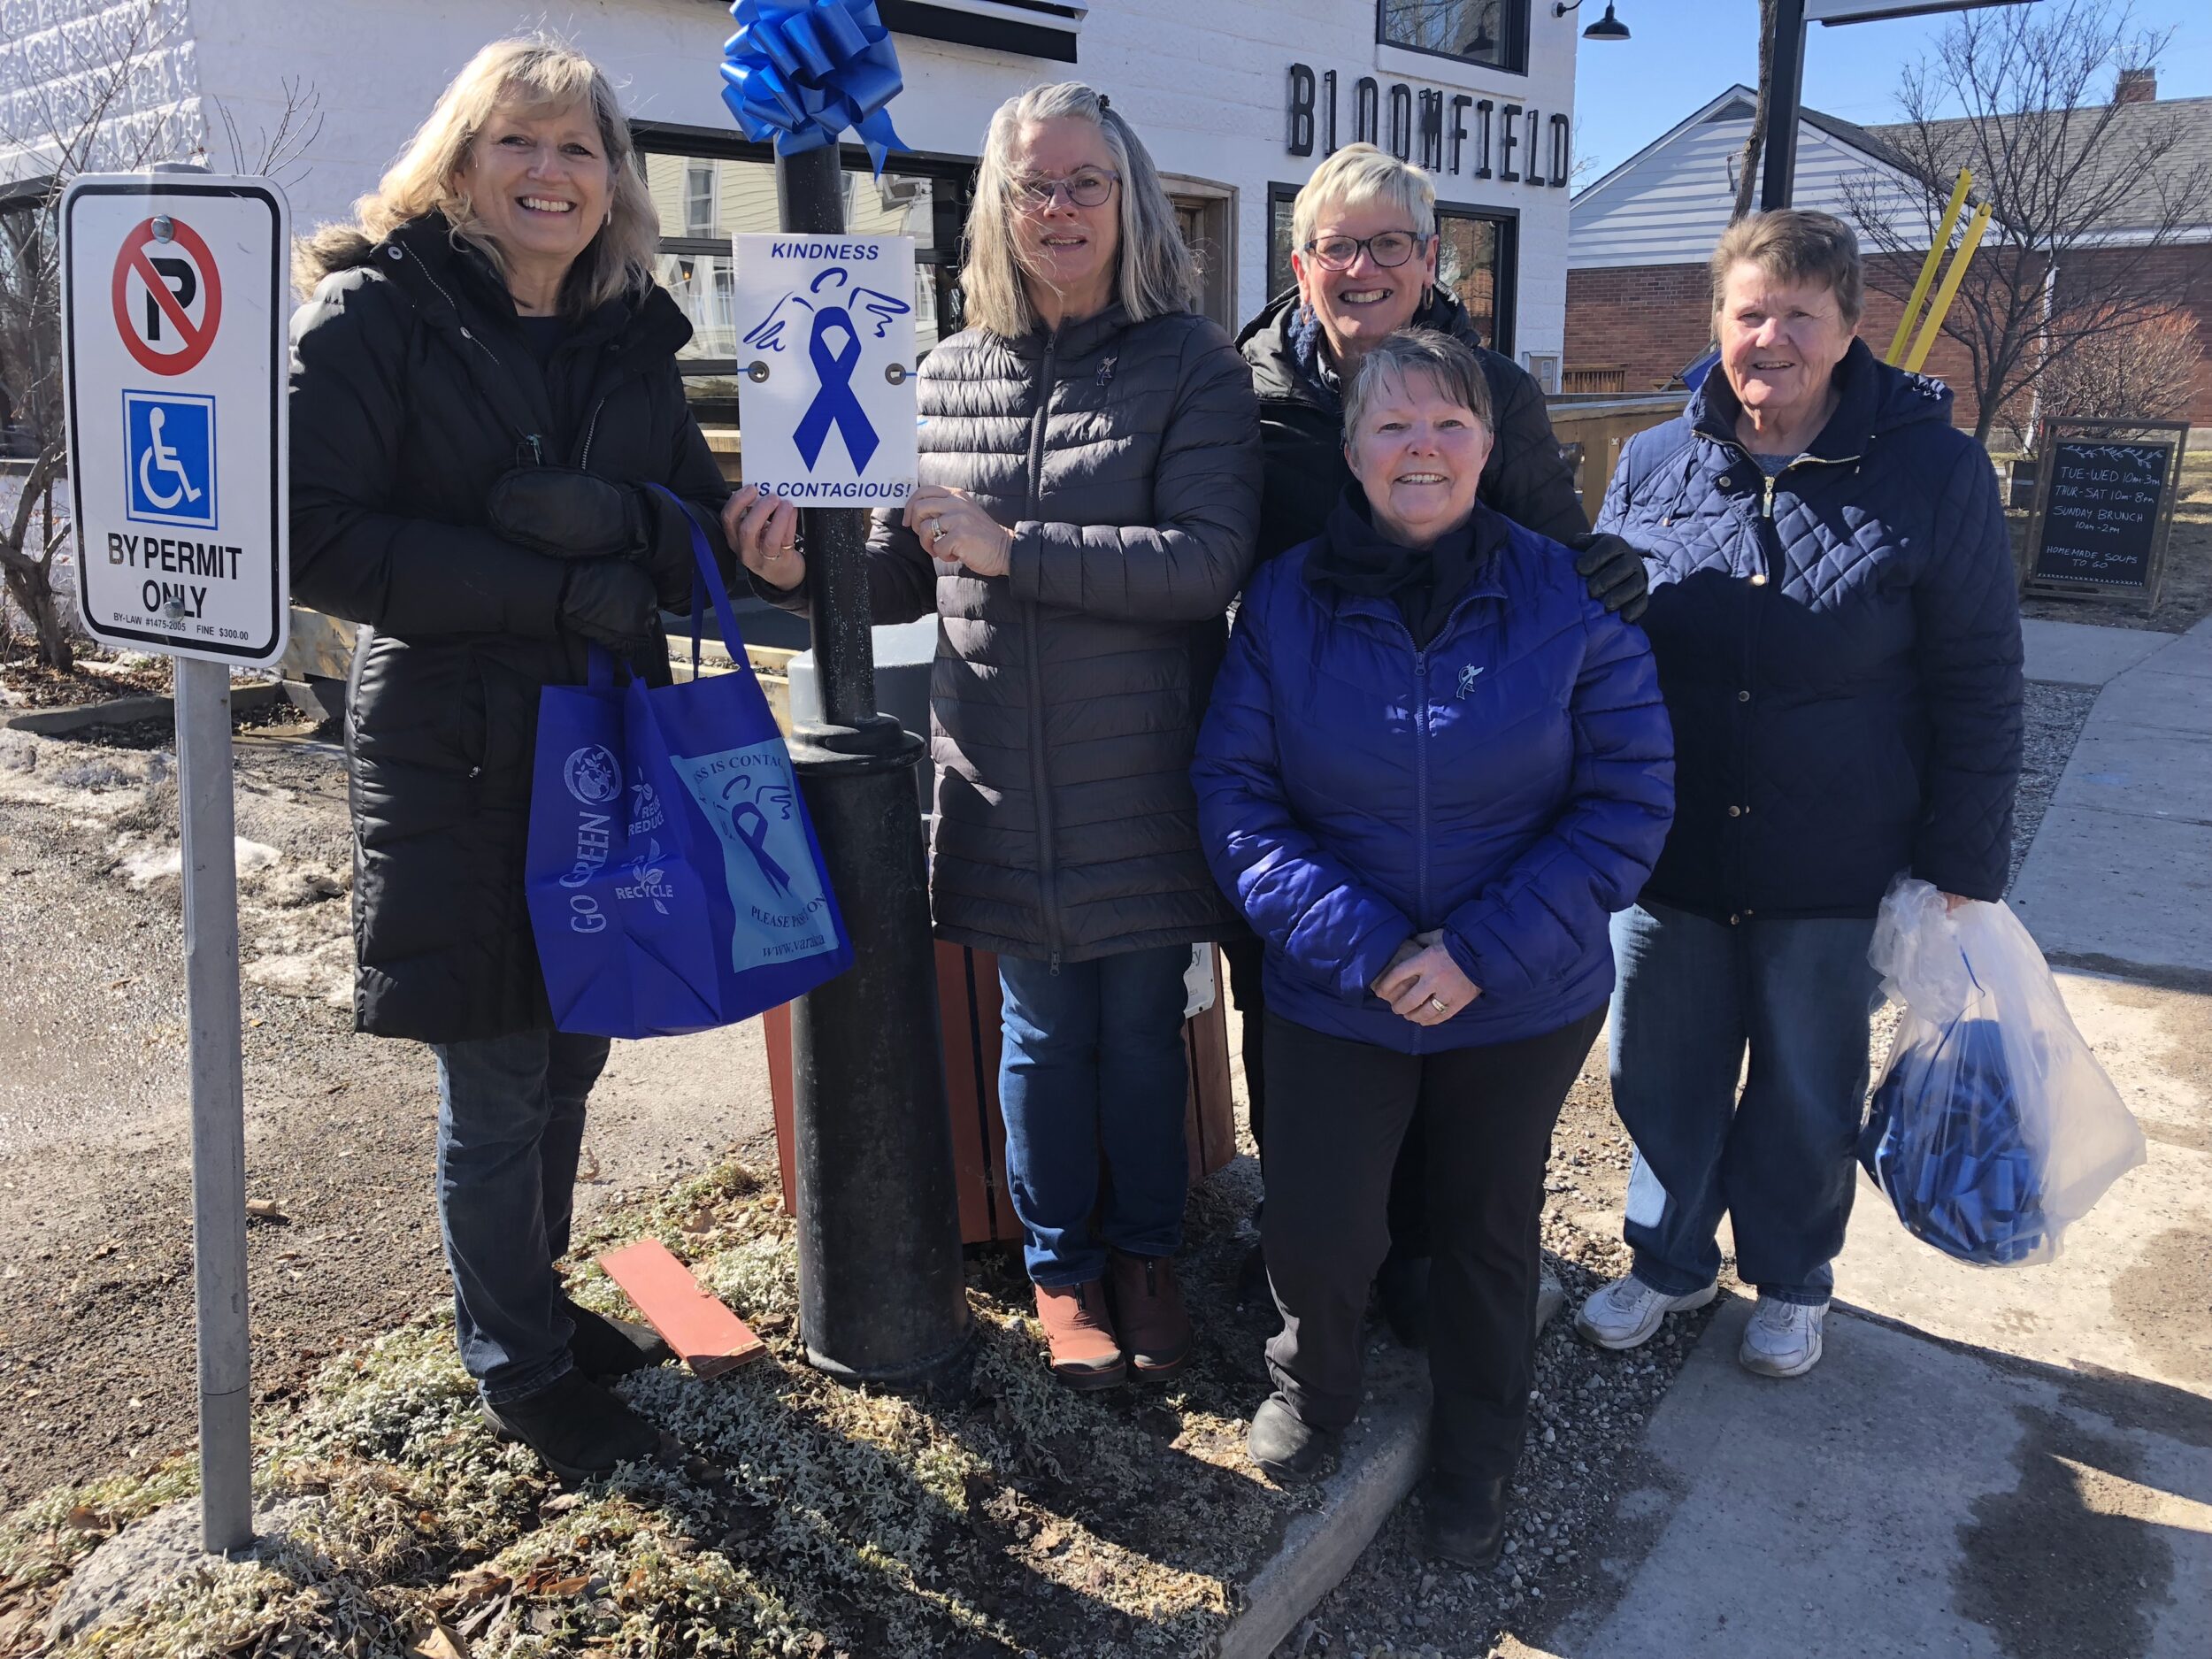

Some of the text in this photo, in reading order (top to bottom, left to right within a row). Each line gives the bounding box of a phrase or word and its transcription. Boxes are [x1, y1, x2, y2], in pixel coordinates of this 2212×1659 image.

[1290, 62, 1570, 188] BLOOMFIELD
[771, 242, 879, 260] KINDNESS
[146, 257, 196, 342] P
[2061, 466, 2119, 482] TUE-WED
[776, 481, 911, 498] CONTAGIOUS!
[2055, 485, 2108, 500] THUR-SAT
[2053, 505, 2143, 523] SUNDAY BRUNCH
[107, 532, 242, 580] BY PERMIT
[2047, 545, 2139, 565] HOMEMADE SOUPS
[2072, 558, 2108, 569] TO GO
[142, 580, 208, 619] ONLY
[113, 611, 249, 641] BY-LAW #1475-2005 FINE $300.00
[710, 760, 726, 774] IS
[627, 810, 664, 837] REDUC
[558, 810, 611, 933] GO GREEN
[614, 884, 673, 901] RECYCLE
[751, 905, 790, 928] PLEASE
[806, 892, 826, 913] ON
